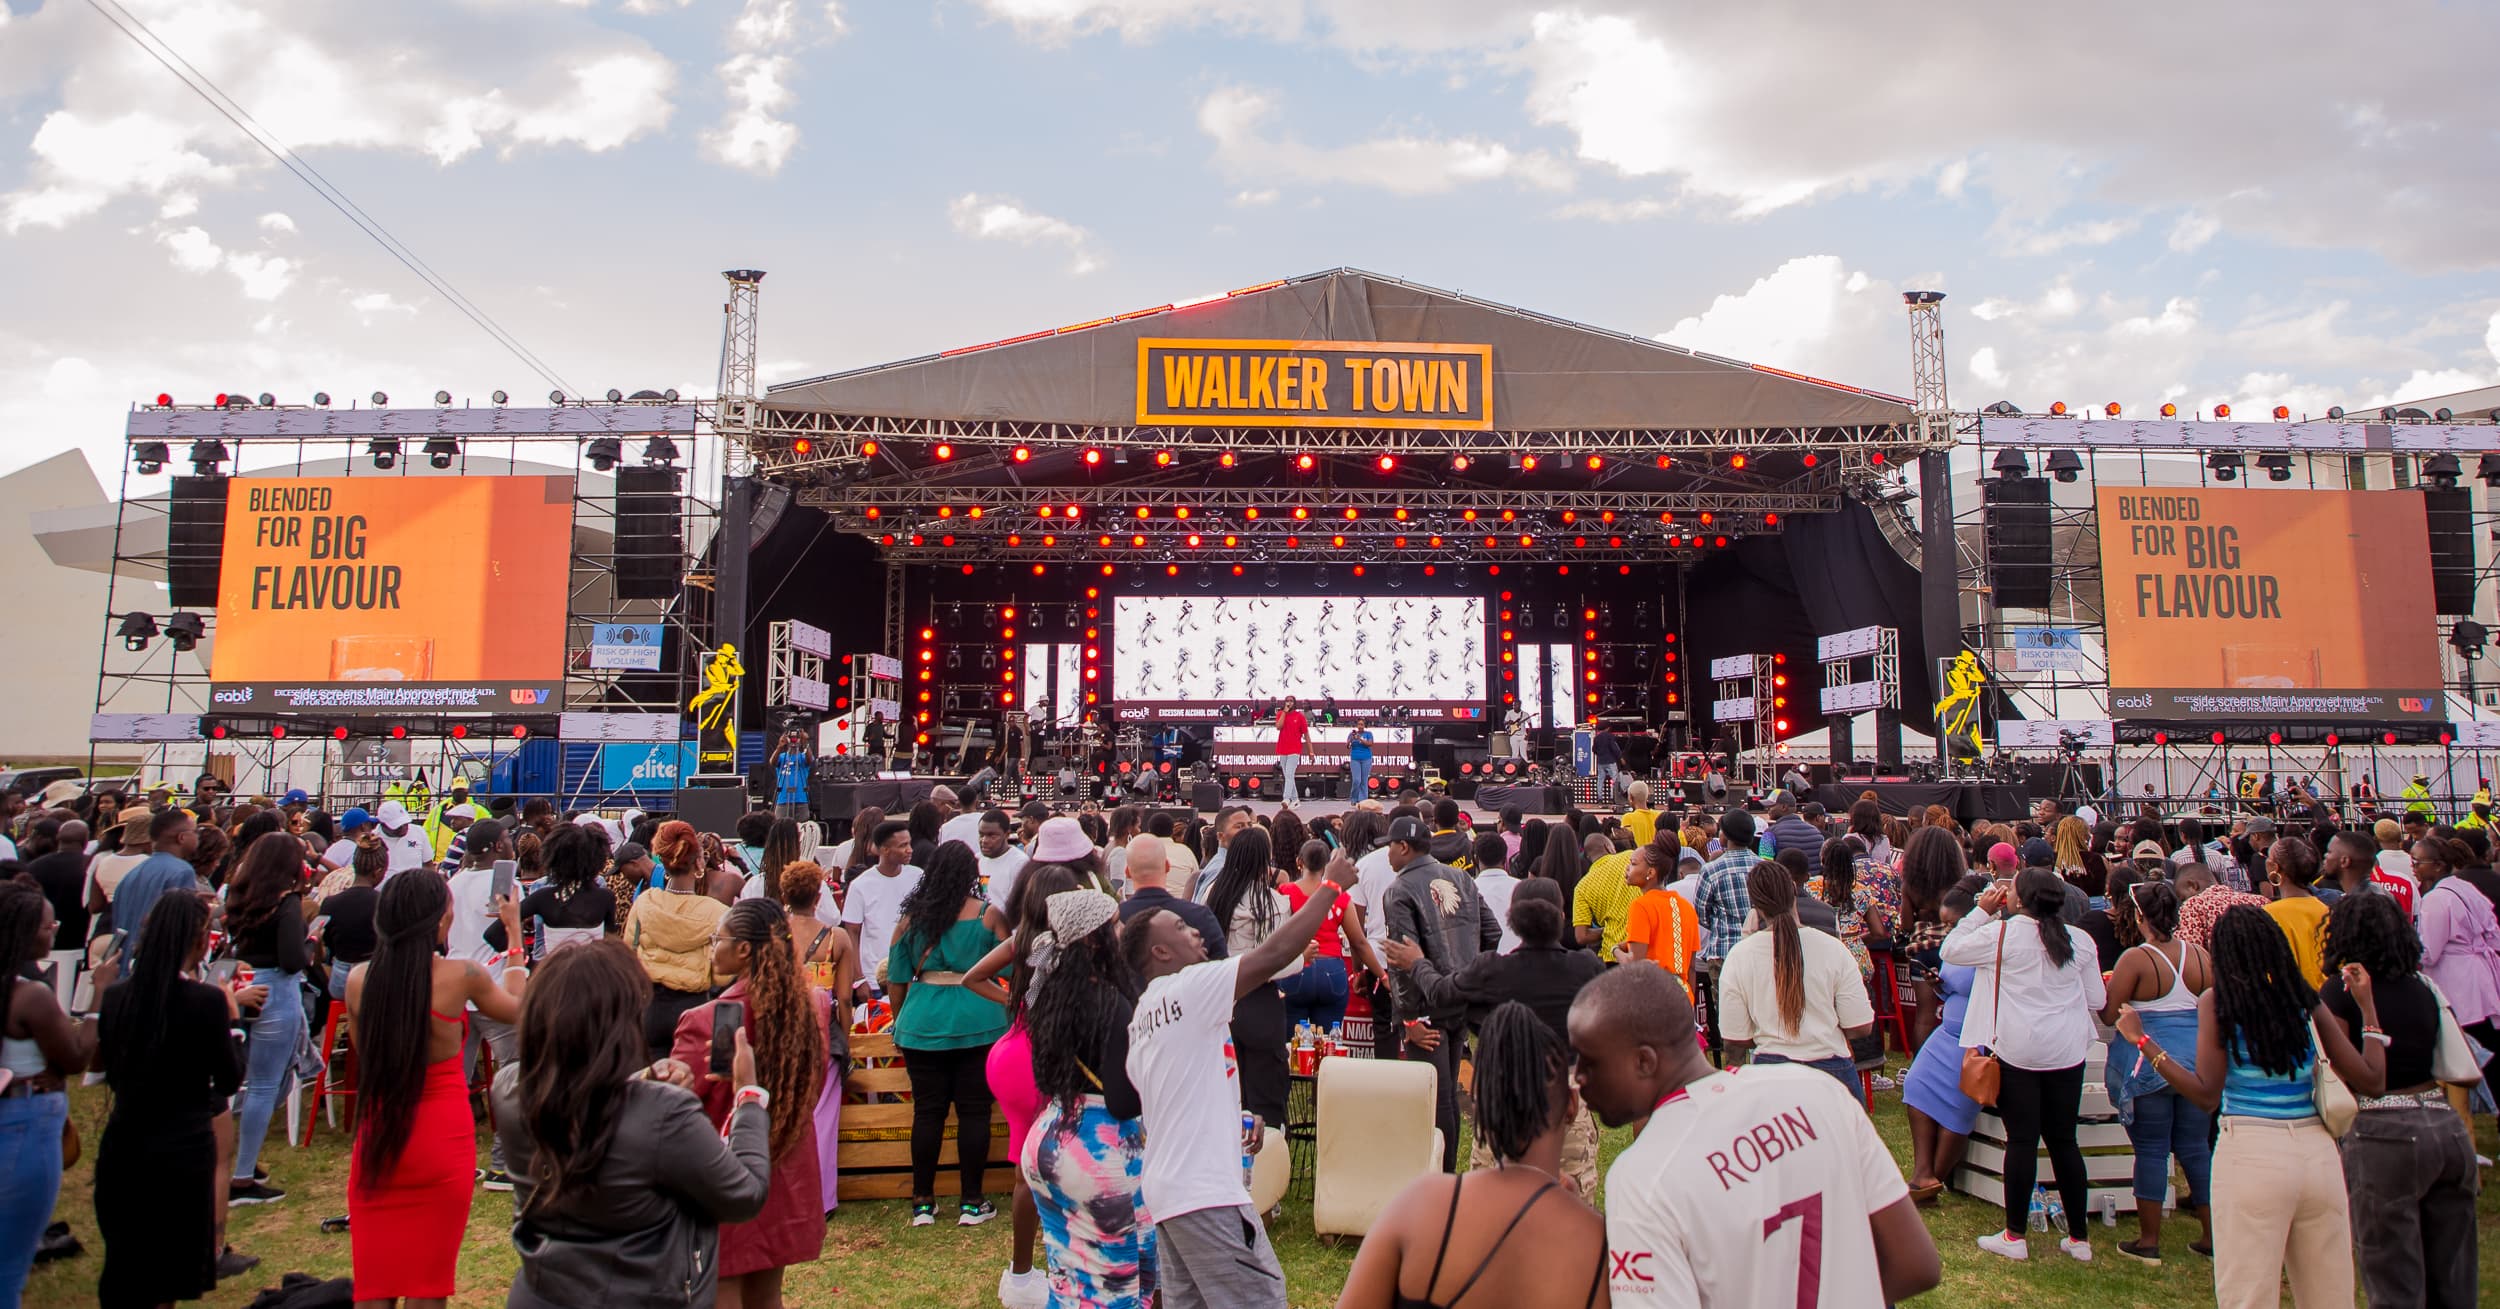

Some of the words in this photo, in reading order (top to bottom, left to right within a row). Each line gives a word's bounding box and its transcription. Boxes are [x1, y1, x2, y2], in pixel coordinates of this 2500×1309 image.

[1163, 355, 1328, 411] WALKER
[1345, 358, 1468, 414] TOWN
[250, 487, 332, 512] BLENDED
[2119, 496, 2200, 521] BLENDED
[256, 516, 301, 547] FOR
[310, 515, 367, 560] BIG
[2131, 525, 2176, 556] FOR
[2185, 525, 2240, 570] BIG
[252, 565, 402, 610] FLAVOUR
[2136, 574, 2282, 619] FLAVOUR
[596, 648, 617, 656] RISK
[618, 648, 631, 656] OF
[633, 648, 657, 656] HIGH
[2021, 651, 2041, 659] RISK
[2042, 651, 2055, 659] OF
[606, 658, 647, 666] VOLUME
[215, 688, 247, 703] eabl
[294, 688, 318, 700] side
[319, 689, 365, 701] screens
[366, 688, 395, 701] Main
[510, 689, 549, 704] UDV
[2116, 696, 2148, 708] eabl
[2193, 695, 2216, 707] side
[2217, 697, 2260, 707] screens
[2261, 695, 2289, 707] Main
[1120, 708, 1145, 718] eabl
[1452, 707, 1480, 719] UDV
[2398, 697, 2433, 712] UDV
[351, 755, 405, 777] elite
[1218, 754, 1246, 766] ALCOHOL
[1246, 754, 1280, 766] CONSUMP
[1330, 754, 1340, 766] TO
[1396, 754, 1409, 766] FOR
[631, 759, 678, 779] elite
[1346, 1021, 1376, 1040] OWN
[1705, 1105, 1819, 1192] ROBIN
[1762, 1190, 1823, 1309] 7
[1610, 1249, 1655, 1282] XC
[1611, 1284, 1655, 1294] NOLOGY
